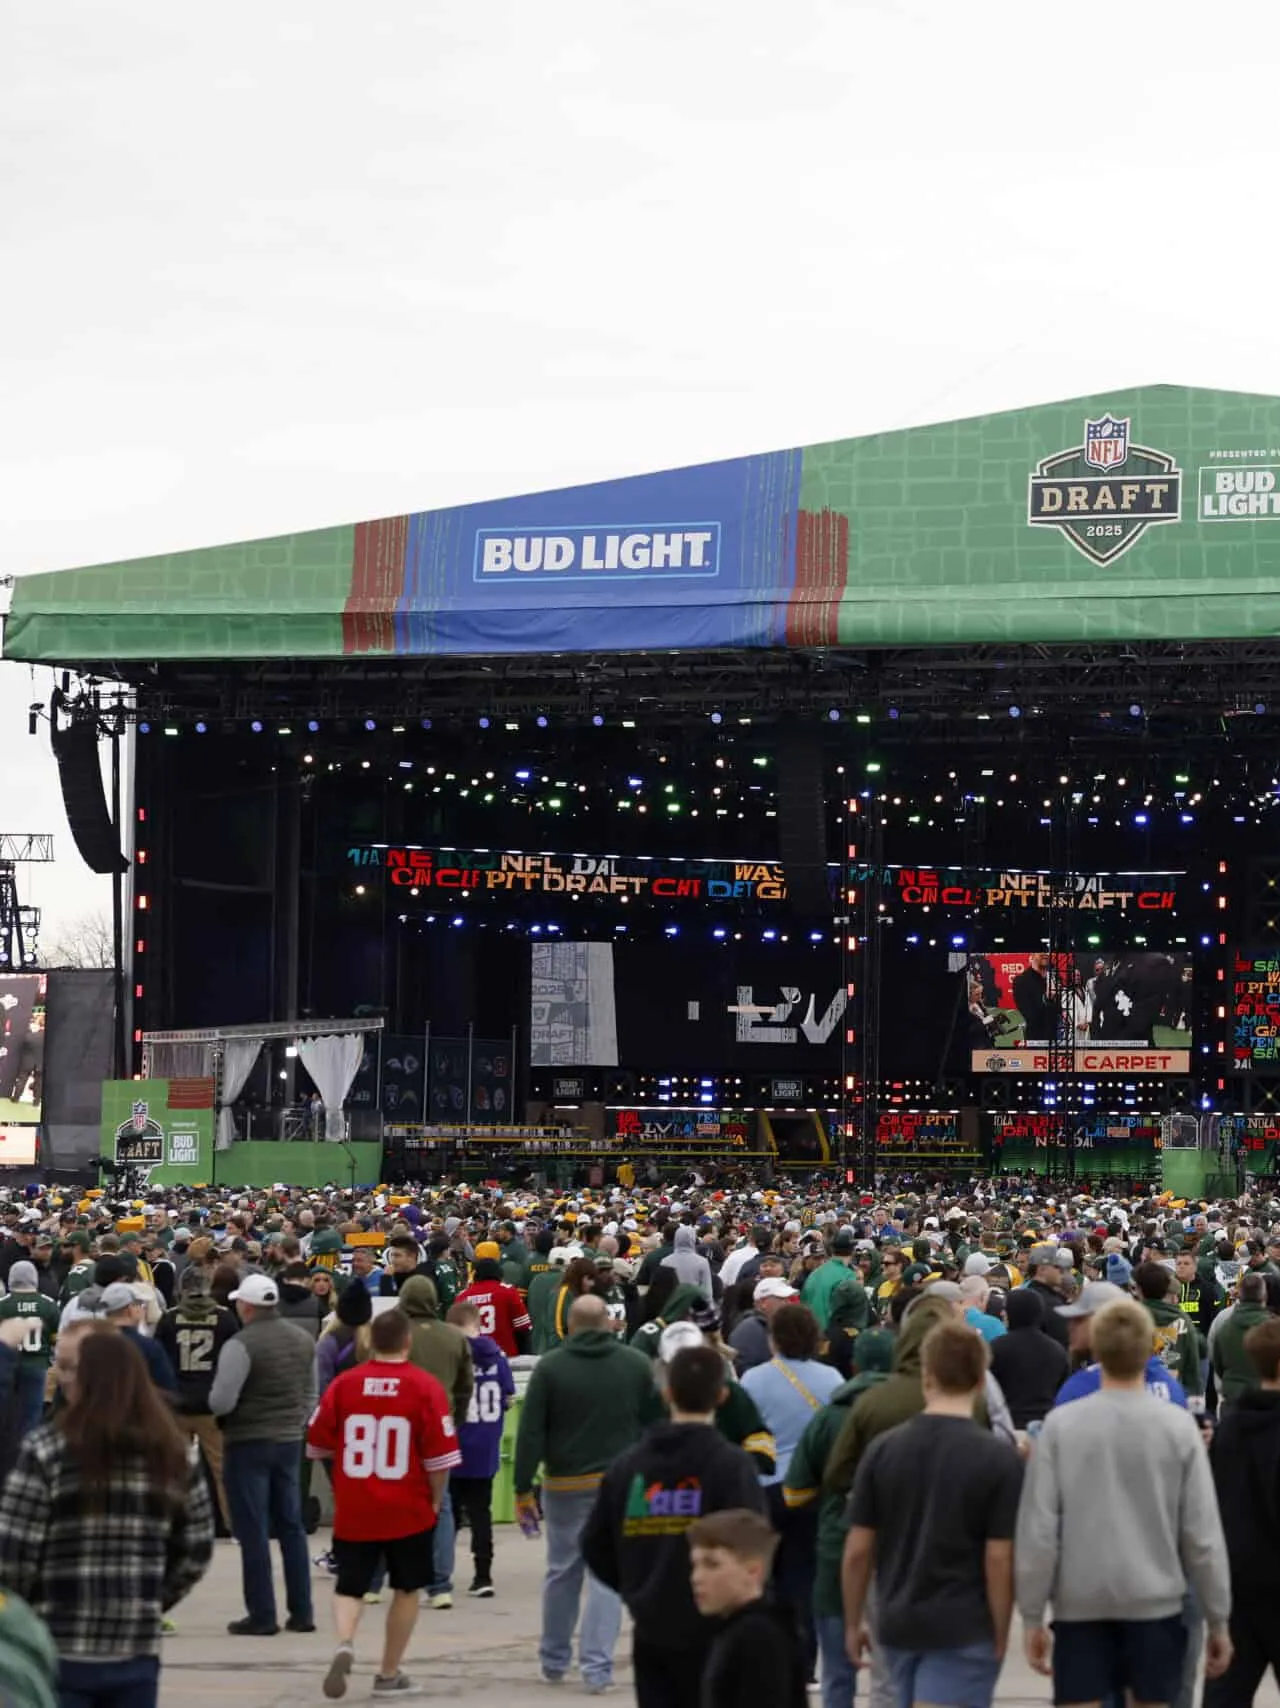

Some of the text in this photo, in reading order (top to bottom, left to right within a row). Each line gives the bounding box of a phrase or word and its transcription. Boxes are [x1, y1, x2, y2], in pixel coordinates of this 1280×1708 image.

[1089, 440, 1121, 464] NFL
[1209, 450, 1265, 458] PRESENTED
[1215, 471, 1275, 493] BUD
[1041, 484, 1168, 512] DRAFT
[1086, 525, 1122, 537] 2025
[483, 532, 711, 573] BUD LIGHT
[501, 856, 562, 873] NFL
[543, 873, 648, 895] DRAFT
[1001, 963, 1025, 973] RED
[1083, 1056, 1172, 1070] CARPET
[173, 1135, 194, 1148] BUD
[170, 1149, 197, 1161] LIGHT
[176, 1328, 215, 1372] 12
[363, 1377, 400, 1397] RICE
[343, 1414, 411, 1480] 80
